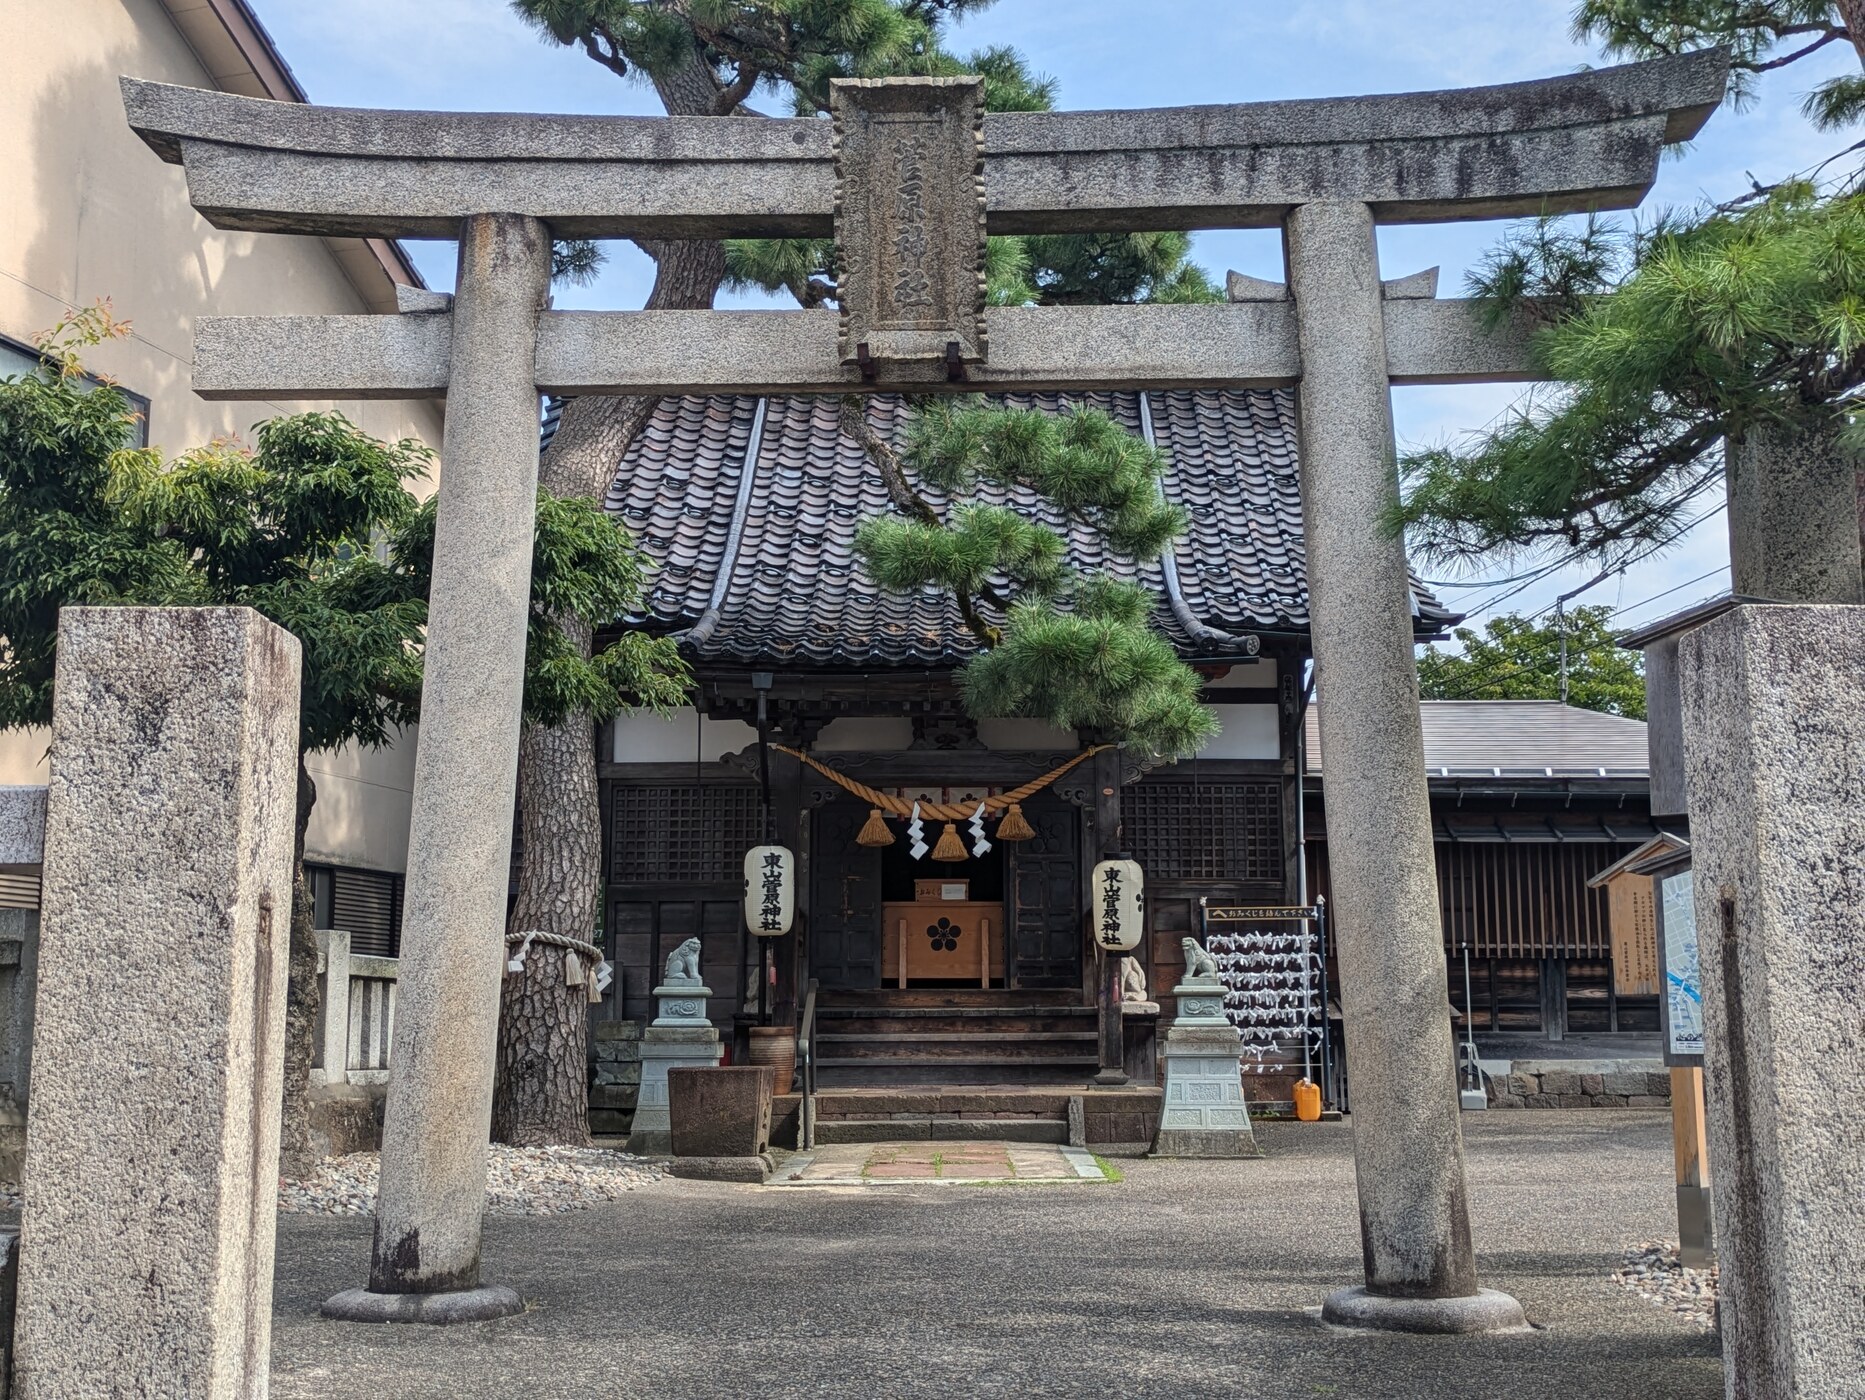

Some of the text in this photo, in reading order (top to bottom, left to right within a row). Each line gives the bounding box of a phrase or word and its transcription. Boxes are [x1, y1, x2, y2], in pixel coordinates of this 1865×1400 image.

[892, 134, 932, 308] 菅原神社
[758, 852, 784, 932] 東山菅原神社
[1100, 866, 1124, 946] 東山菅原神社
